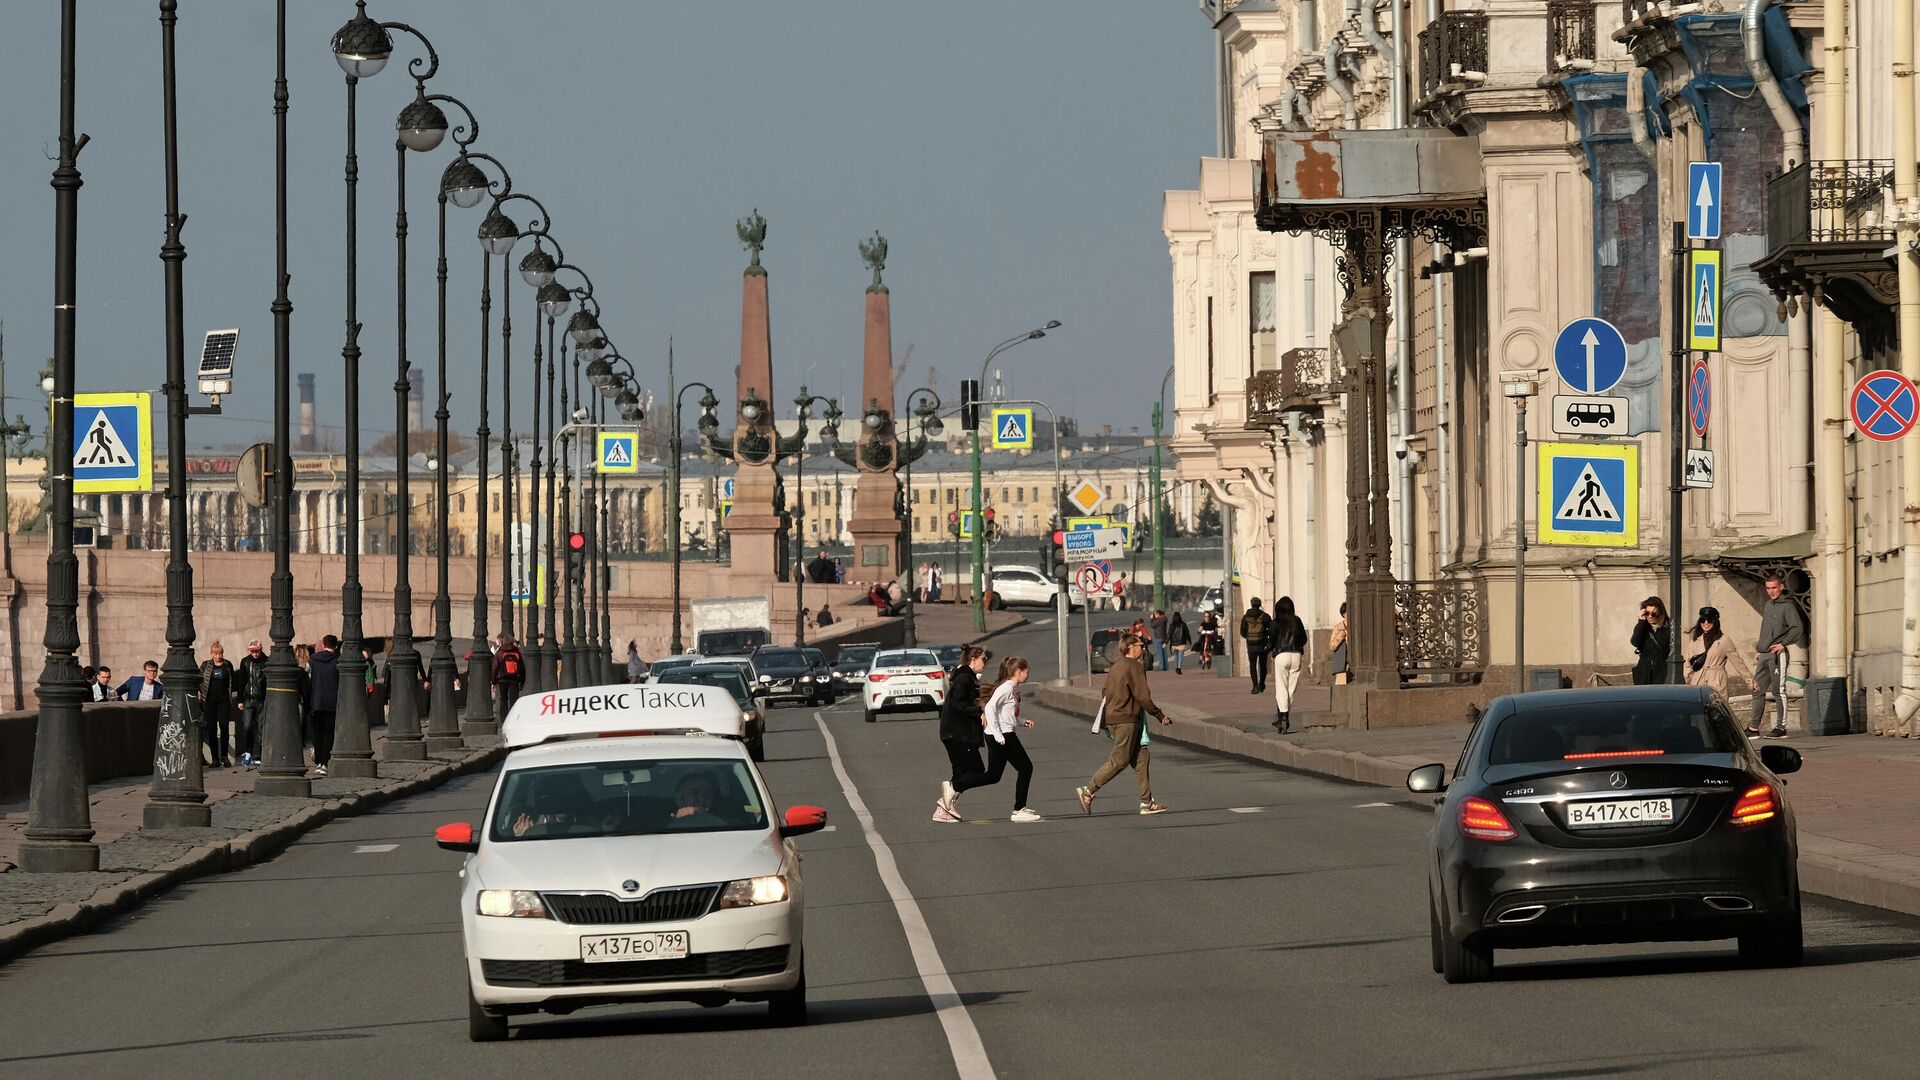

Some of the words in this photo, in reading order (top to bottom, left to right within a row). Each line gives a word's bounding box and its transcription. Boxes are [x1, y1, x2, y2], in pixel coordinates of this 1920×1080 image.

[1067, 540, 1092, 548] VYBORG
[540, 693, 630, 716] Яндекс
[635, 687, 705, 709] Такси
[1643, 801, 1667, 813] 178
[657, 933, 682, 947] 799
